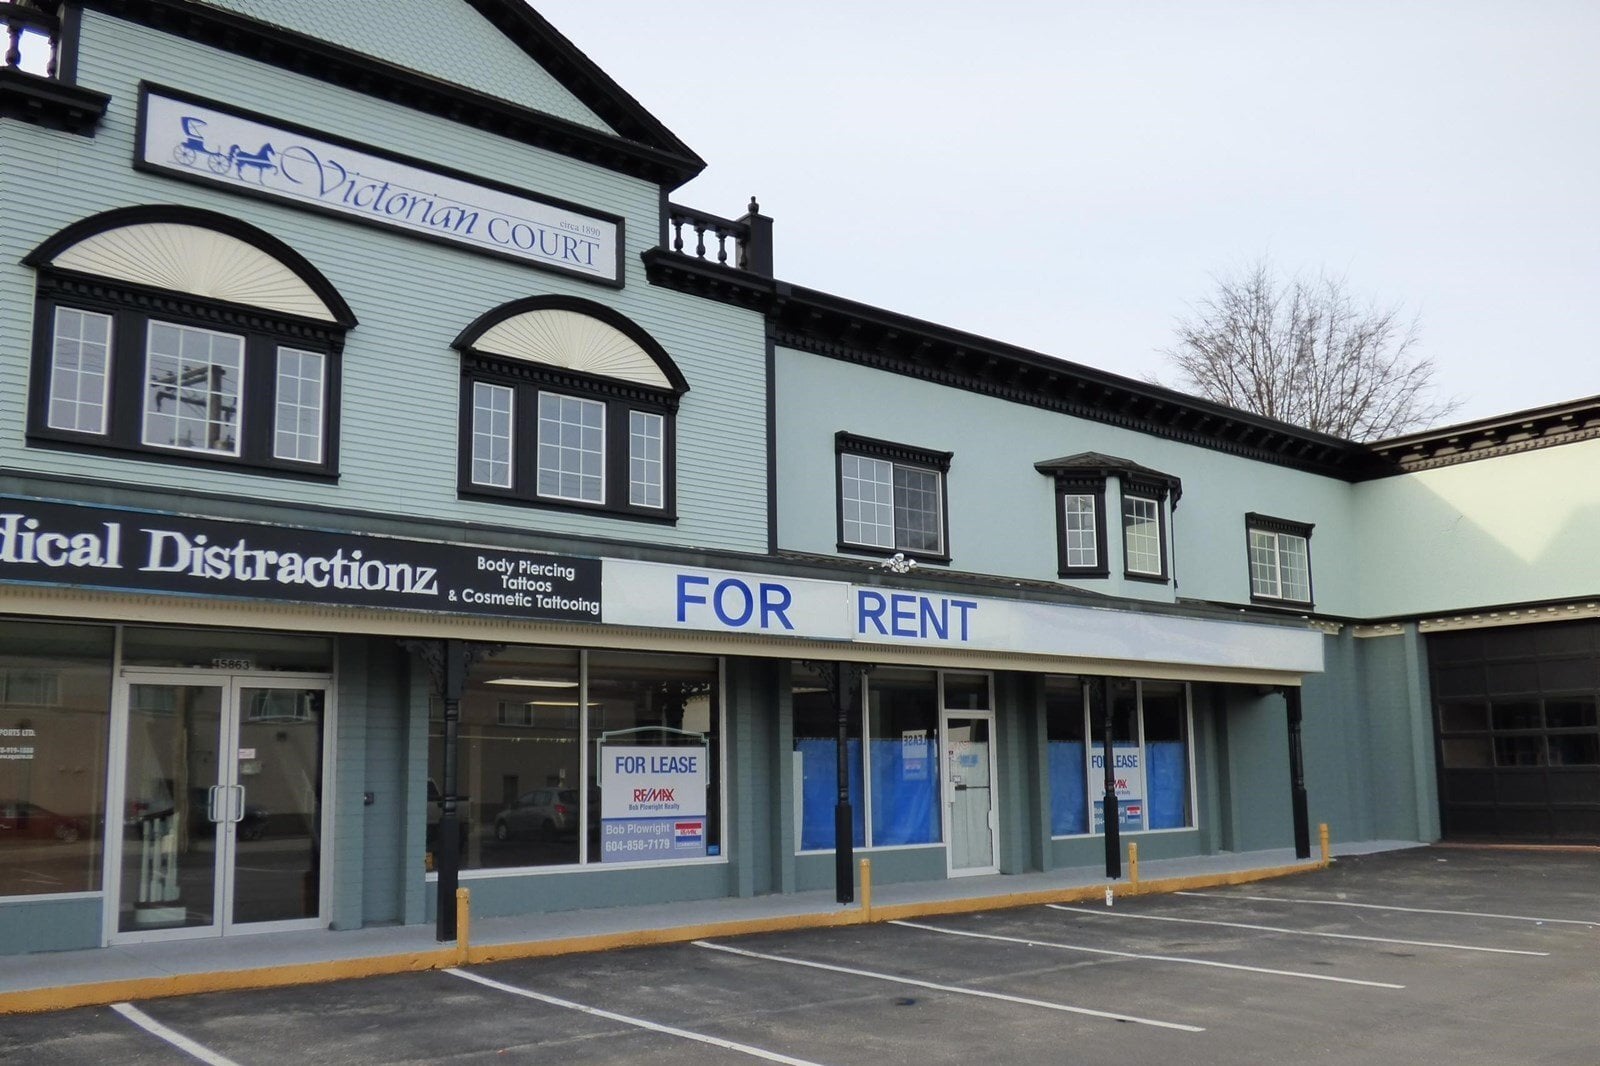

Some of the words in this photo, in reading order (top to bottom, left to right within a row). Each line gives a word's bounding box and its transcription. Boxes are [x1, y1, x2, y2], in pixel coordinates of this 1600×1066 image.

[281, 145, 479, 235] Victorian
[487, 217, 600, 266] COURT
[560, 220, 579, 232] circa
[582, 225, 600, 237] 1890
[138, 529, 439, 595] Distractionz
[477, 556, 515, 575] Body
[519, 560, 576, 581] Piercing
[501, 575, 553, 592] Tattoos
[448, 589, 458, 601] &
[462, 588, 532, 607] Cosmetic
[536, 594, 600, 615] Tattooing
[676, 574, 795, 630] FOR
[857, 590, 978, 642] RENT
[615, 756, 646, 774] FOR
[651, 756, 697, 774] LEASE
[633, 788, 675, 803] RE/MAX
[606, 824, 625, 835] Bob
[627, 822, 670, 835] Plowright
